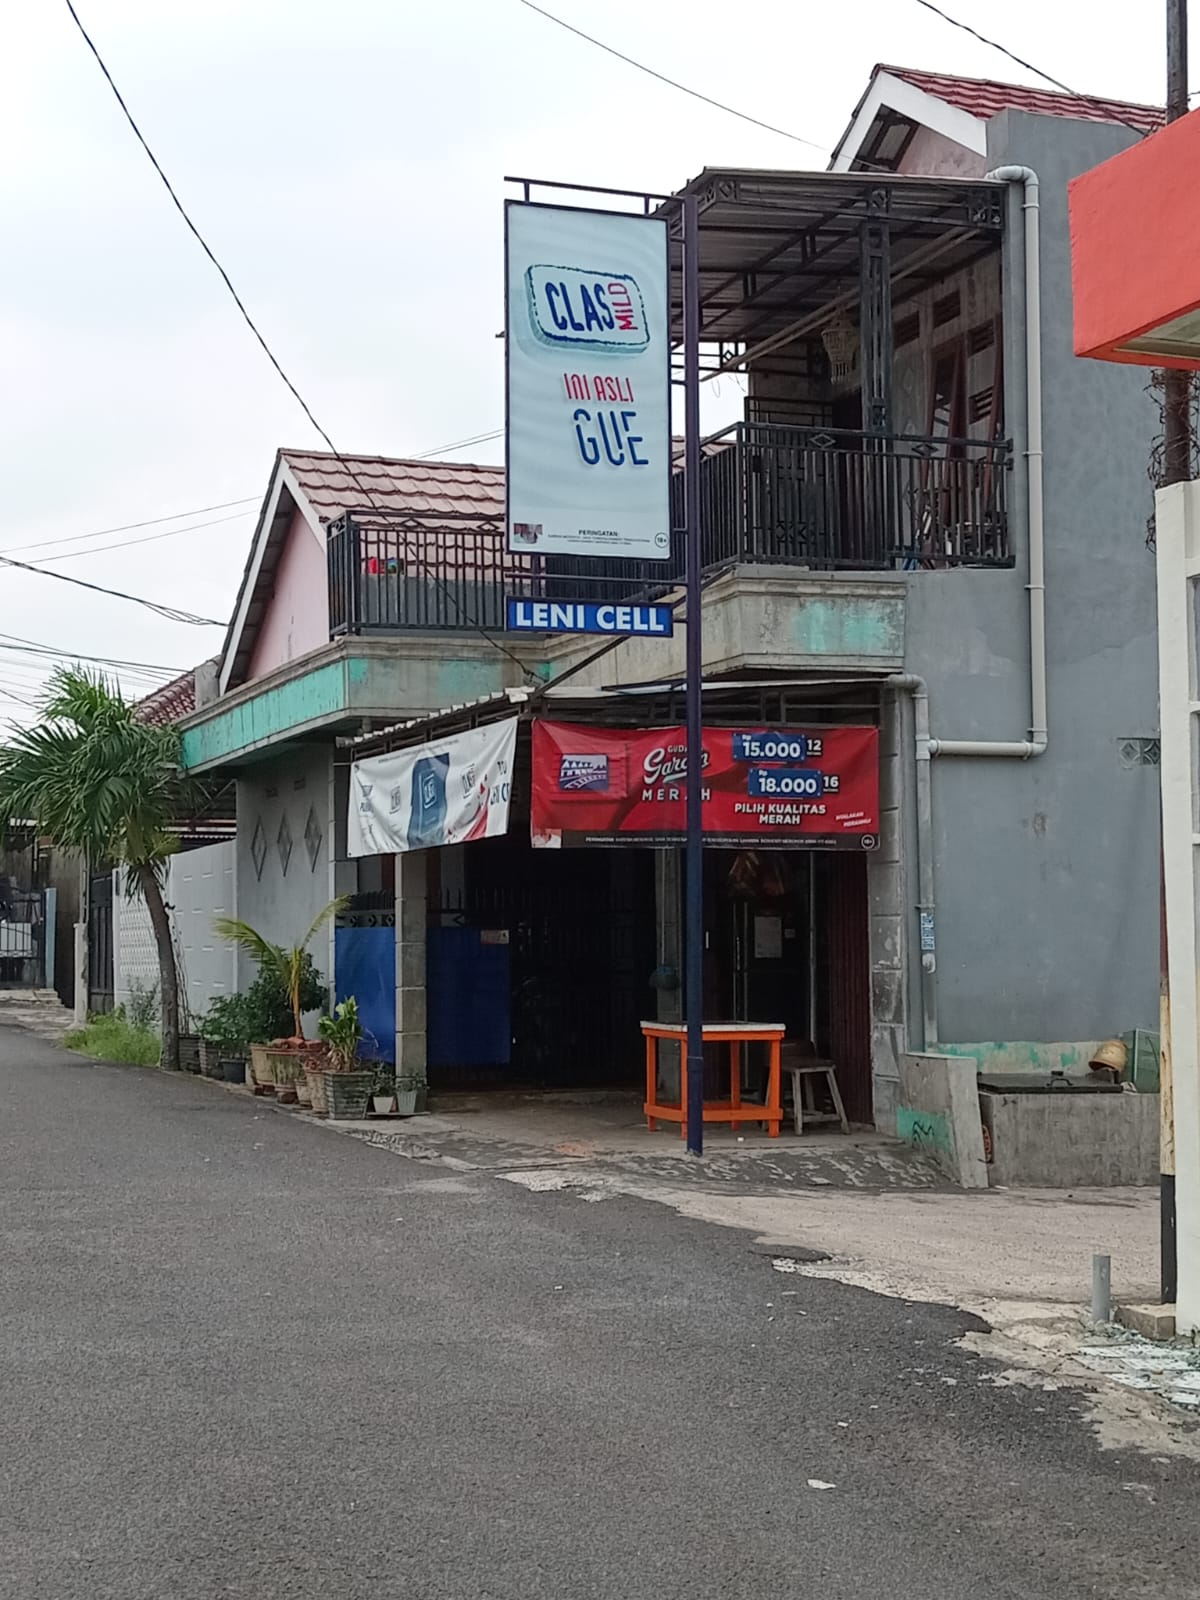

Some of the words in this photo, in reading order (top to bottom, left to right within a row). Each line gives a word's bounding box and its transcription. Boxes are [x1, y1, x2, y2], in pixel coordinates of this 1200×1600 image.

[545, 282, 615, 332] CLAS
[607, 282, 639, 331] MILD
[563, 372, 591, 401] INI
[593, 375, 634, 403] ASLI
[573, 408, 649, 466] GUE
[516, 602, 585, 629] LENI
[596, 605, 665, 632] CELL
[743, 741, 801, 758] 15.000
[807, 739, 822, 751] 12
[758, 777, 817, 794] 18.000
[823, 776, 839, 788] 16
[642, 788, 711, 801] MERH
[734, 803, 765, 814] PILIH
[768, 803, 827, 815] KUALITAS
[759, 815, 801, 825] MERAH
